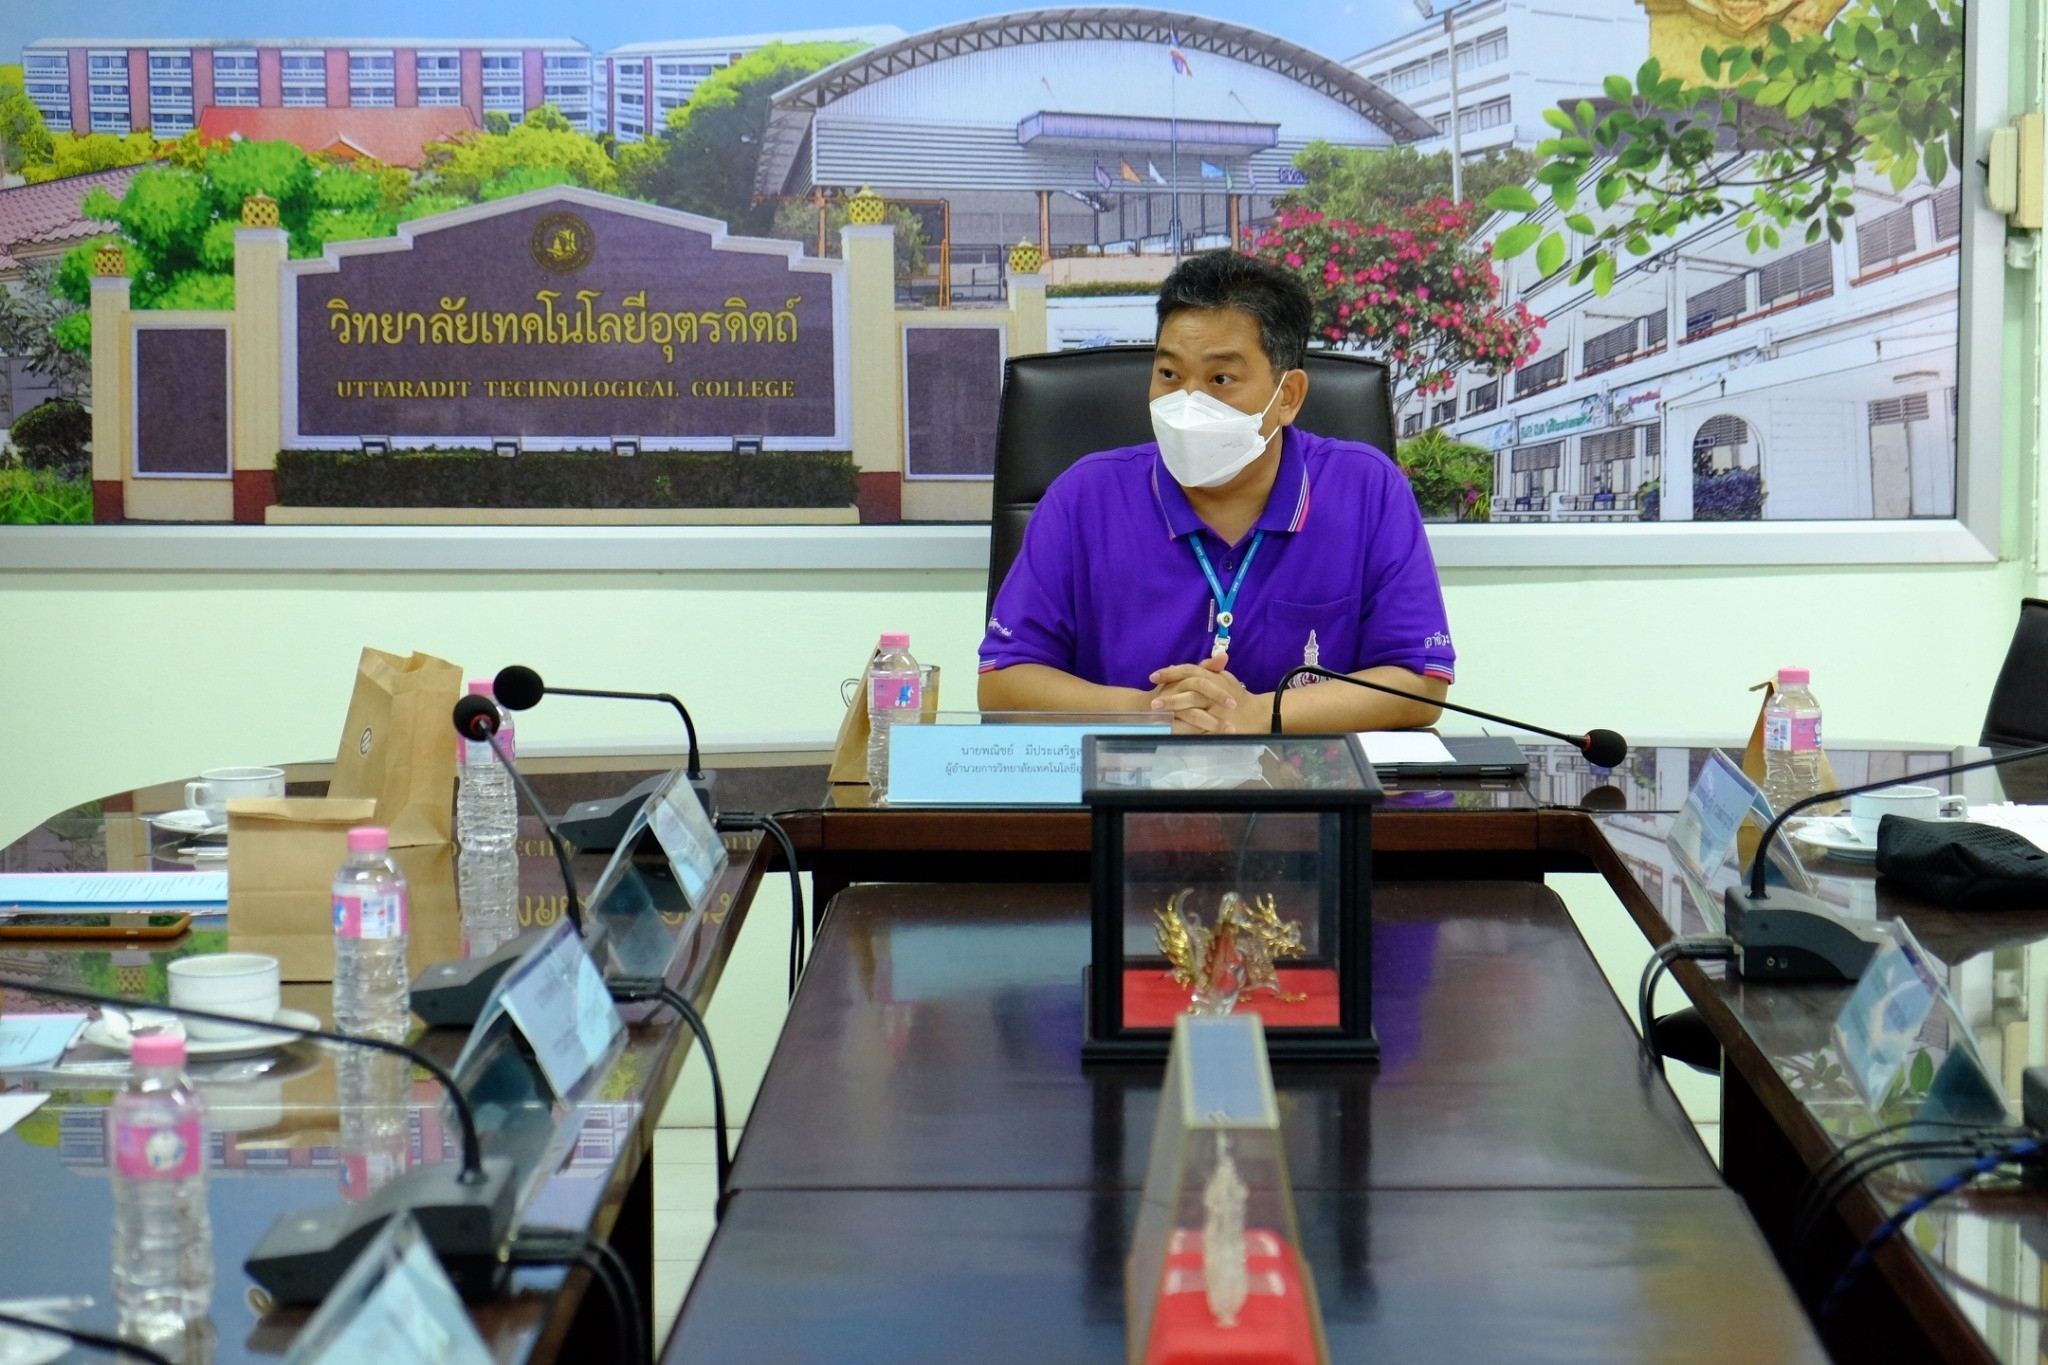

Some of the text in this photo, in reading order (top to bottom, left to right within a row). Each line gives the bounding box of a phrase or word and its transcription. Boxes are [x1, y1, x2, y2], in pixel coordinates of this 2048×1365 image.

[327, 288, 801, 364] วิทยาลัยเทคโนโลยีอุตรดิตถ์
[336, 380, 795, 399] UTTARADIT TECHNOLOGICAL COLLEGE
